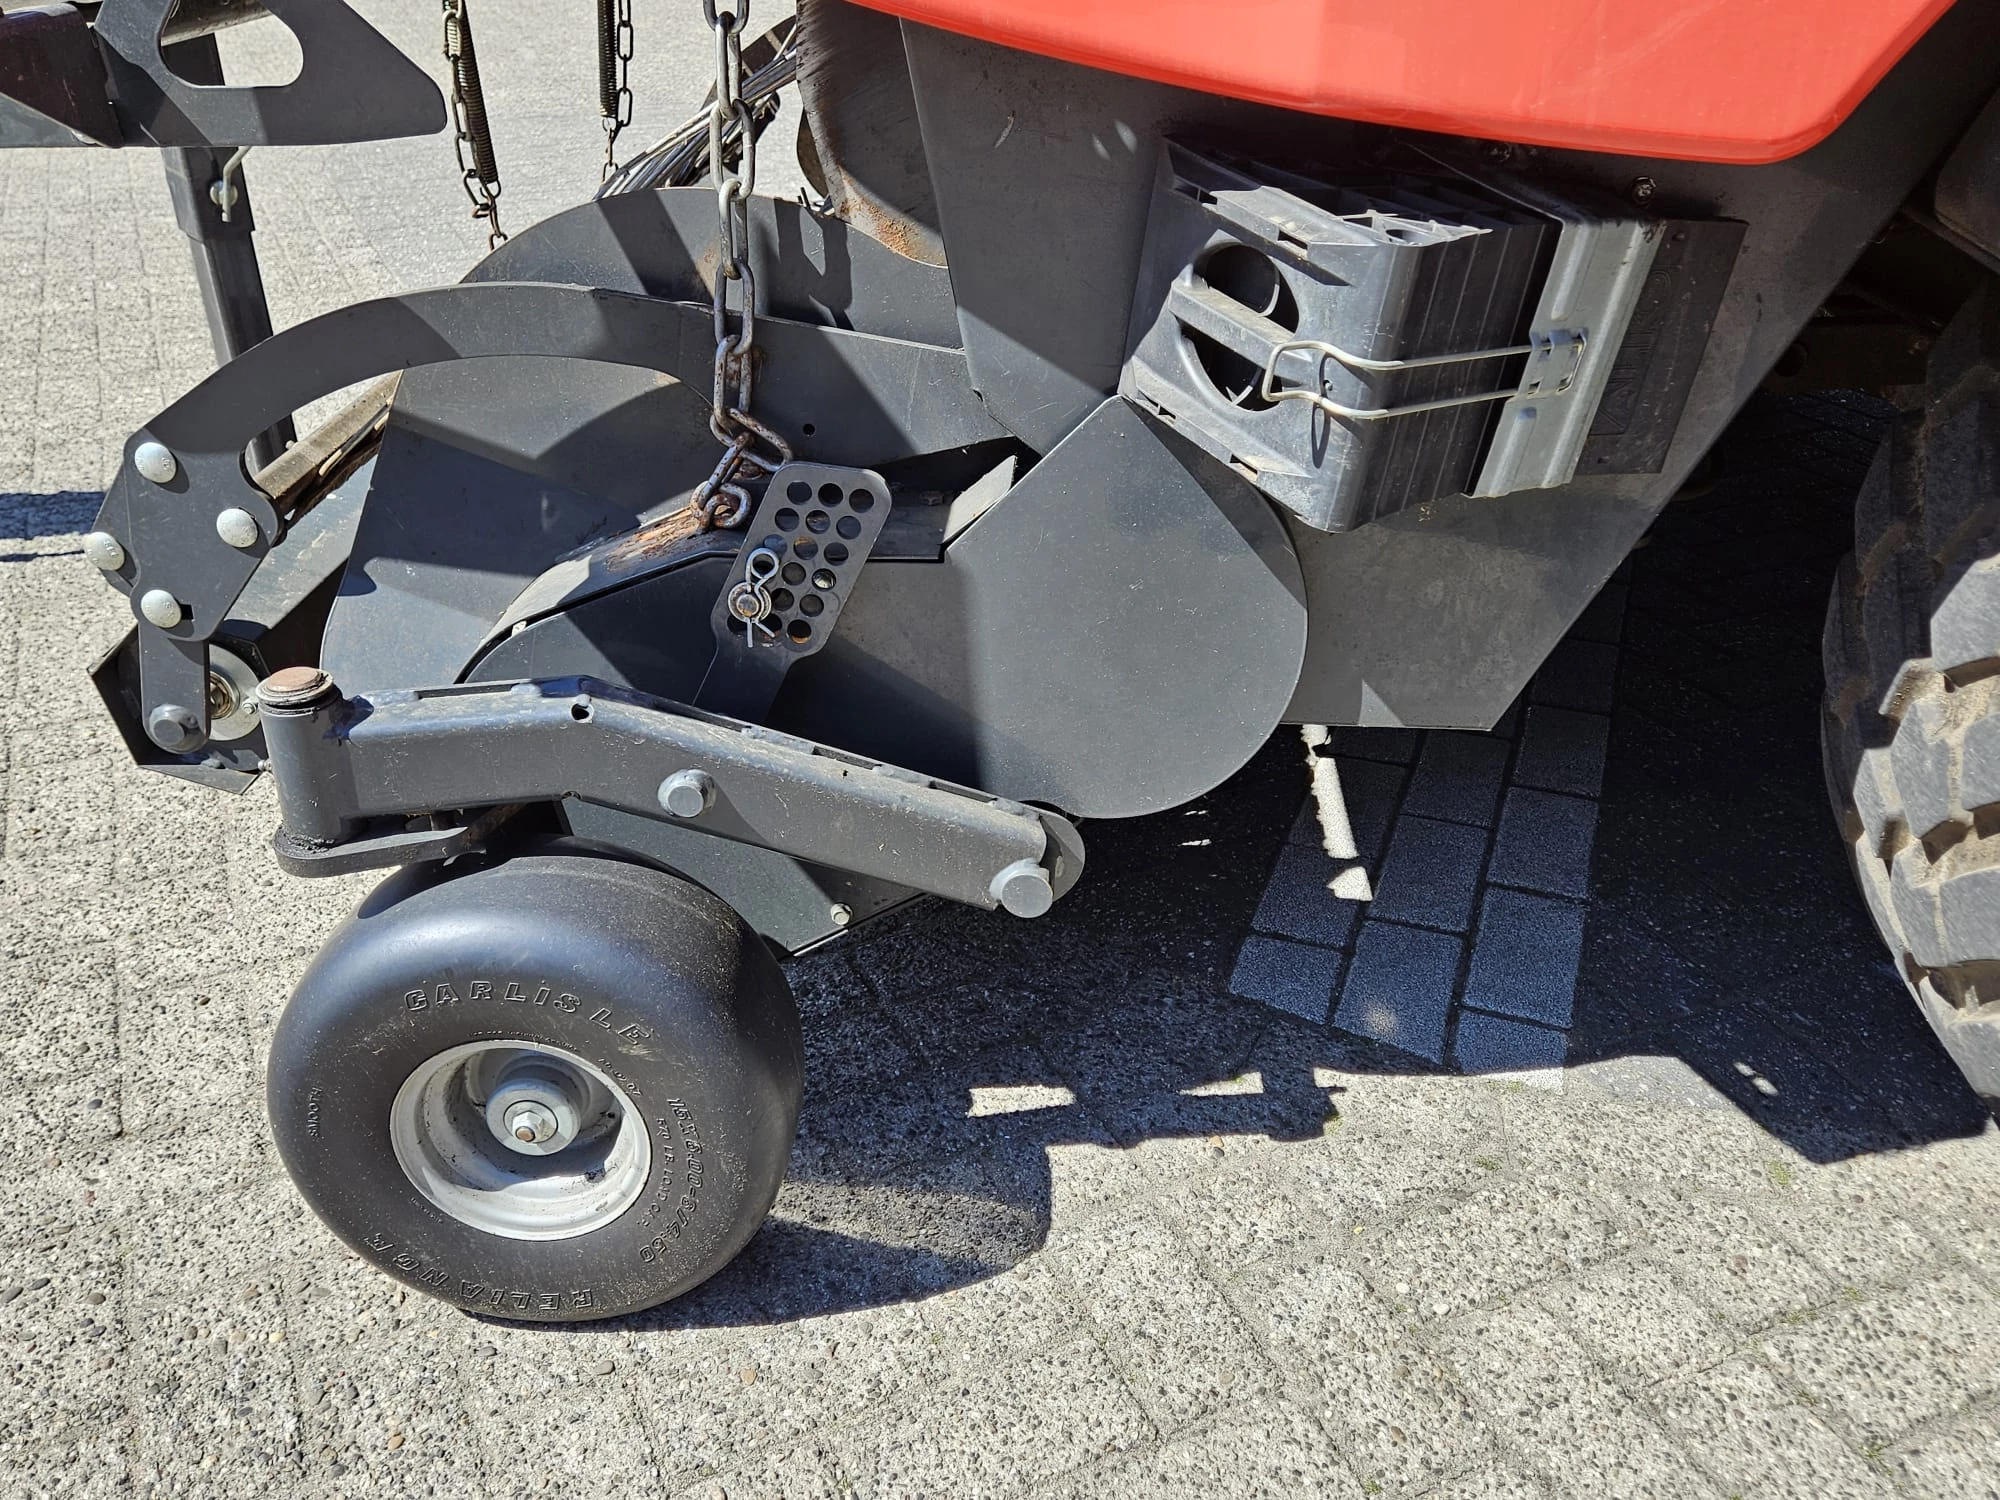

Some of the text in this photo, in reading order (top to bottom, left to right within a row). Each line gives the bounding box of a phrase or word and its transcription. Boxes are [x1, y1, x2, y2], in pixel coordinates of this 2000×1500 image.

[404, 980, 653, 1046] CARLISLE
[308, 1086, 322, 1138] SMOOTH
[366, 1232, 596, 1311] RELIANCE
